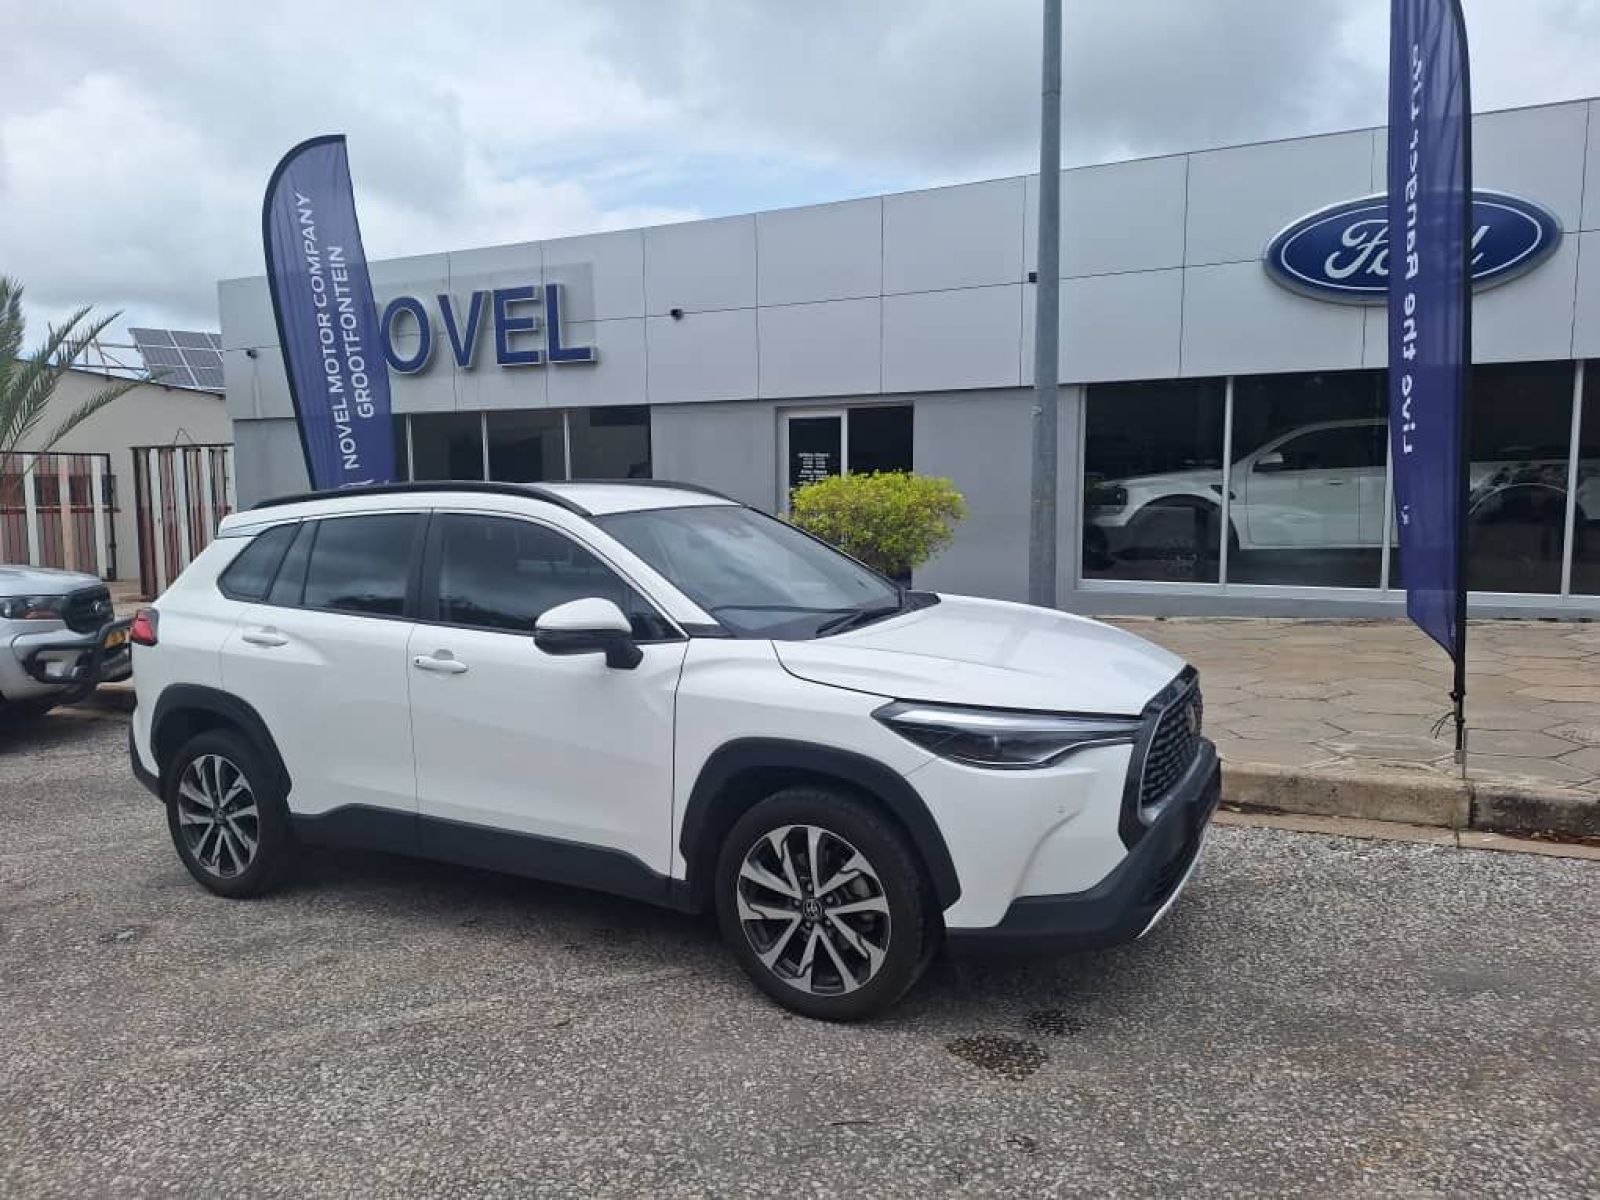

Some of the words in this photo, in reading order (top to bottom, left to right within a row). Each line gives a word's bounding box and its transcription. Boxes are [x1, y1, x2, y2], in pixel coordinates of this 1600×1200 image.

[295, 192, 327, 308] COMPANY
[315, 312, 345, 394] MOTOR
[327, 245, 375, 419] GROOTFONTEIN
[379, 283, 597, 374] OVEL
[332, 397, 360, 470] NOVEL
